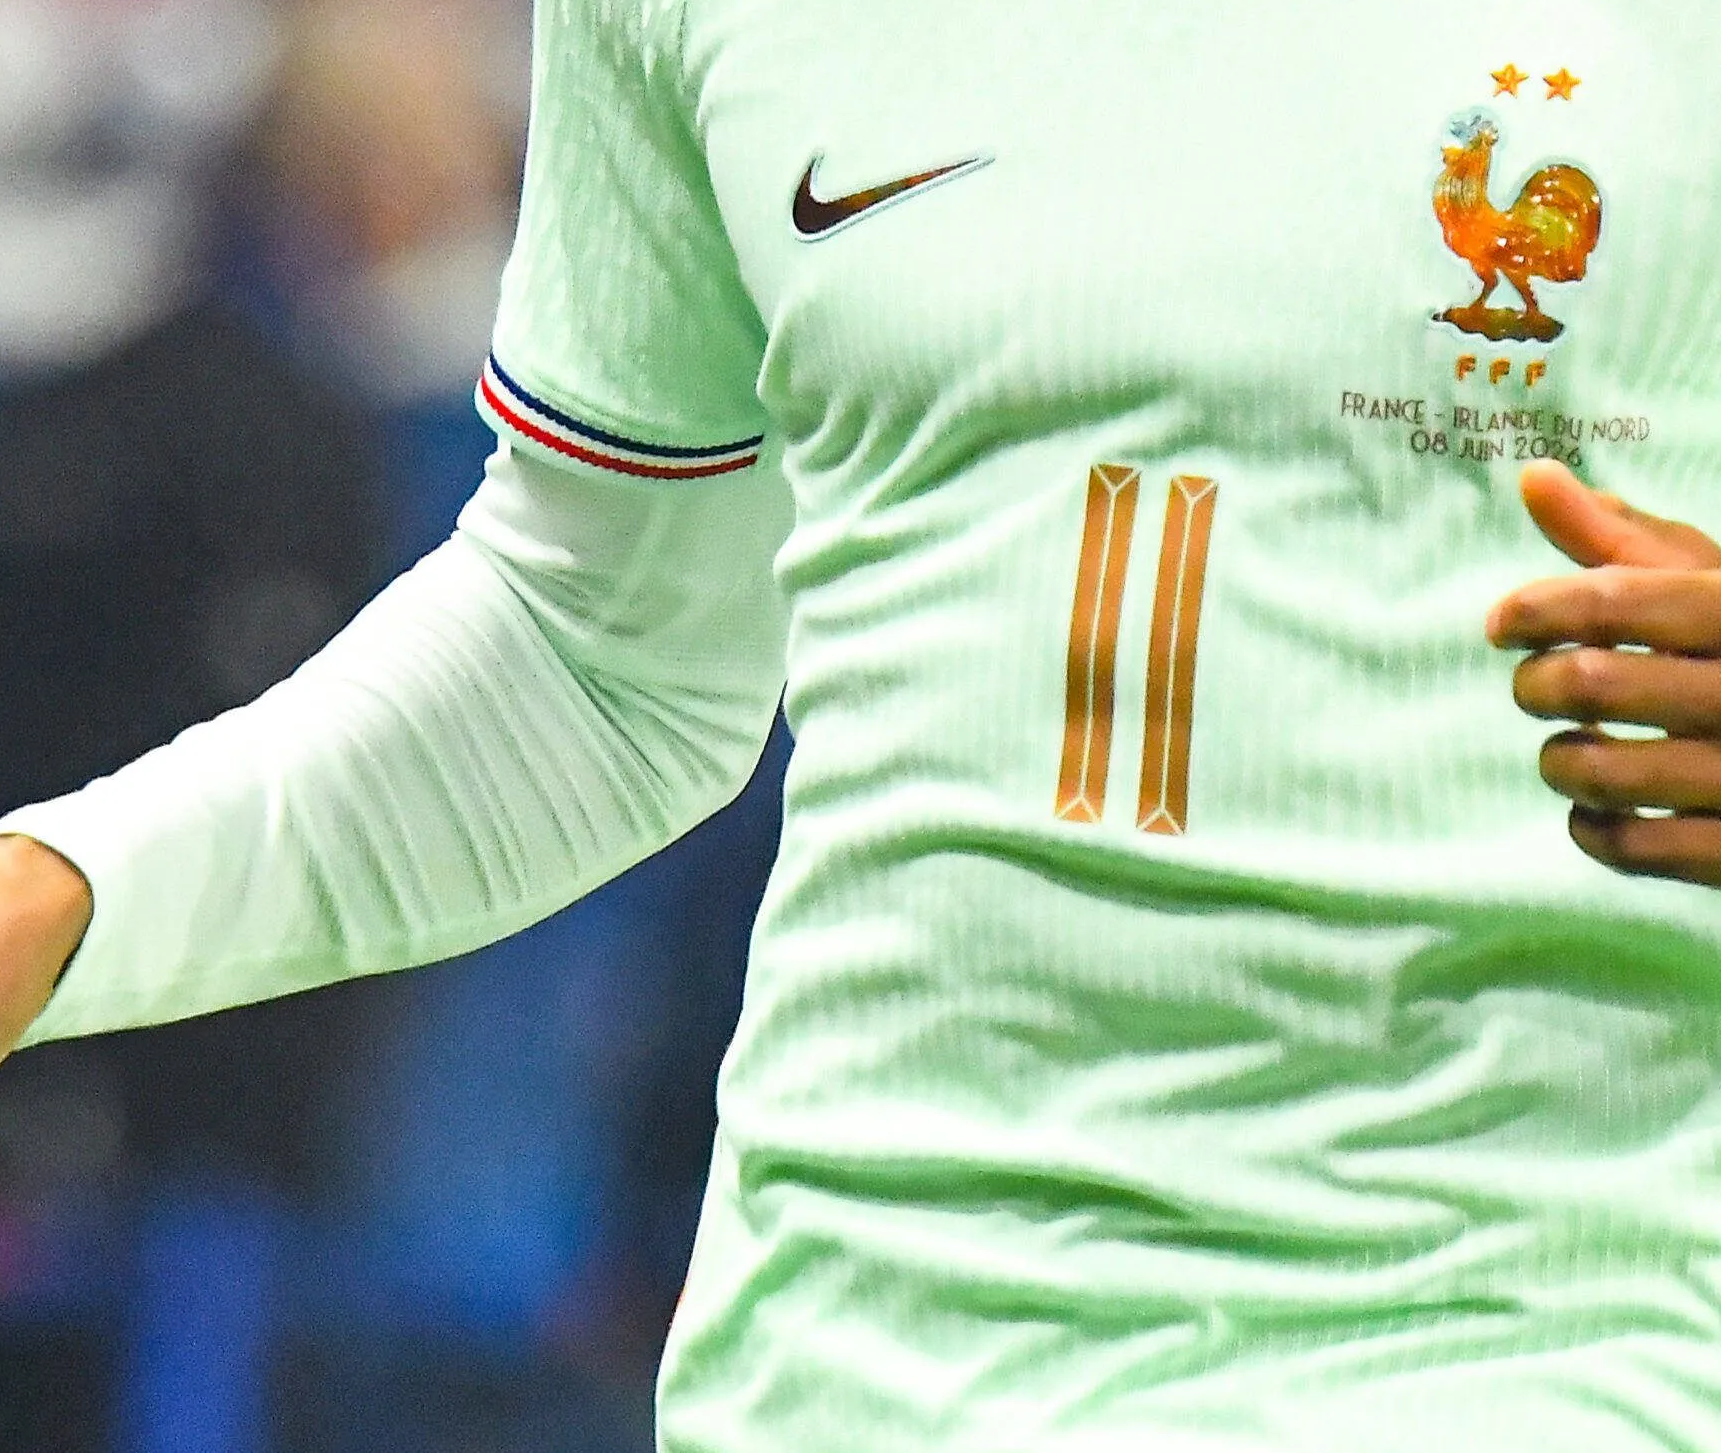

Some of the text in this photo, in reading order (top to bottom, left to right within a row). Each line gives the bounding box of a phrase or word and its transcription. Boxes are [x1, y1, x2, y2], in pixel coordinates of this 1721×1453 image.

[1341, 391, 1425, 424] FRANCE
[1452, 405, 1544, 432] IRLANDE
[1554, 413, 1582, 441] DU
[1591, 415, 1650, 443] NORD
[1410, 429, 1448, 454] 08
[1456, 437, 1504, 461] JUIN
[1055, 462, 1219, 836] 11
